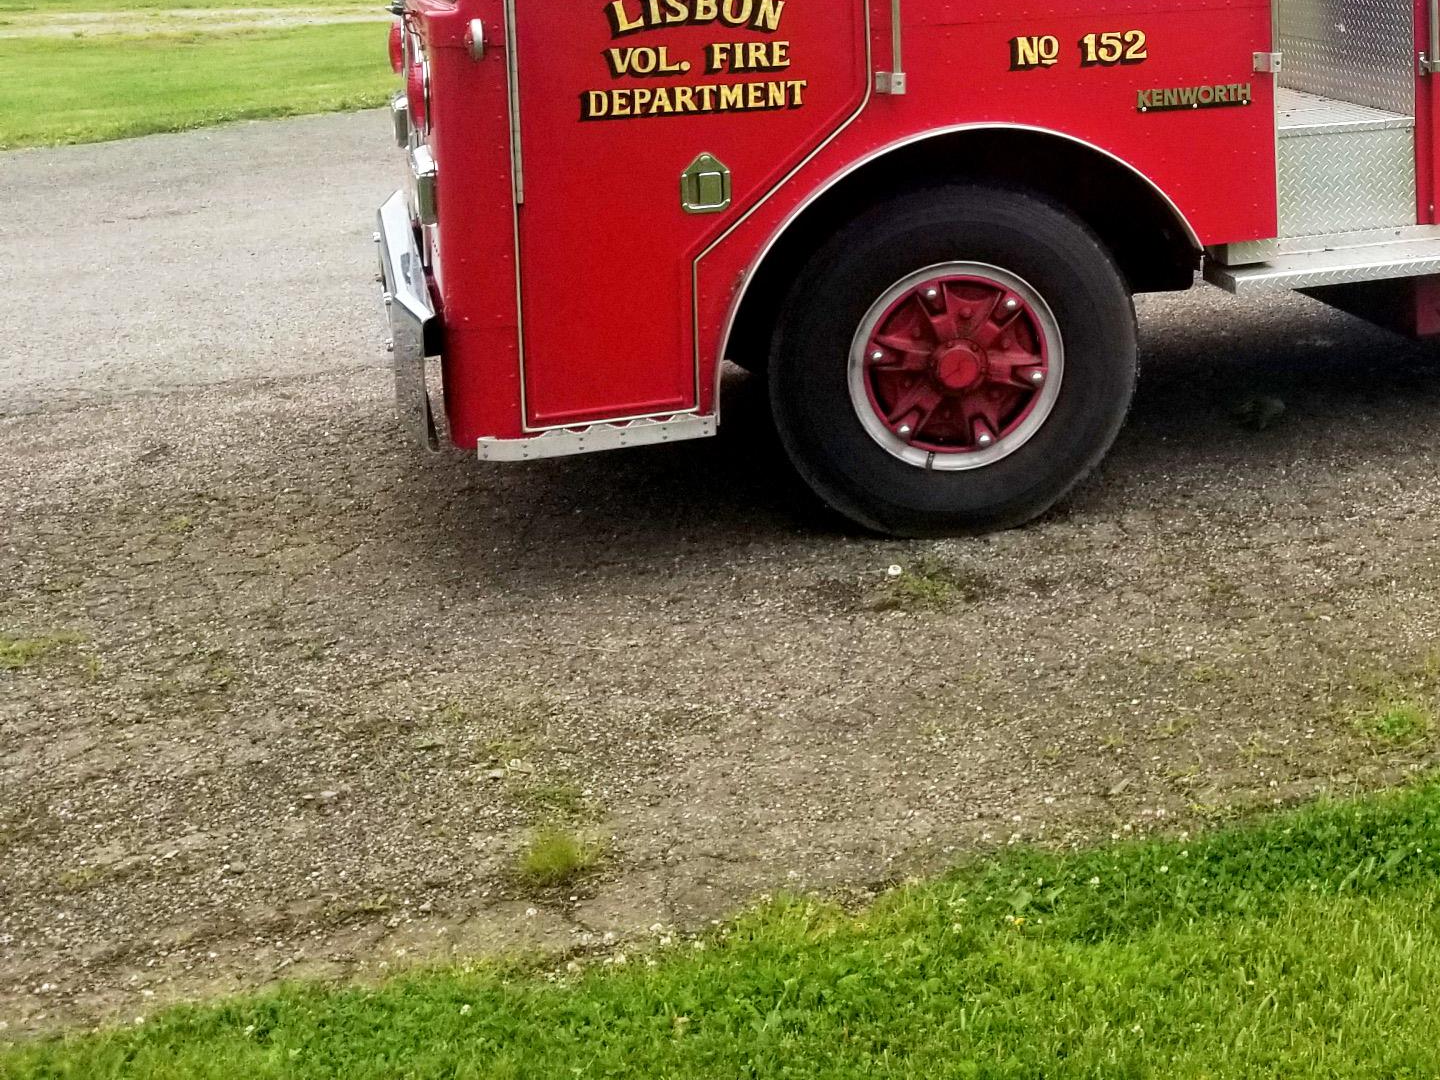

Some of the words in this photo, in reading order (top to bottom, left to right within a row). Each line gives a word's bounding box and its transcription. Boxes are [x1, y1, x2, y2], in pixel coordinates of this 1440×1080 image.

[606, 46, 692, 76] VOL.
[708, 40, 791, 71] FIRE
[1080, 29, 1148, 64] 152
[584, 80, 808, 119] DEPARTMENT
[1136, 83, 1252, 110] KENWORTH
